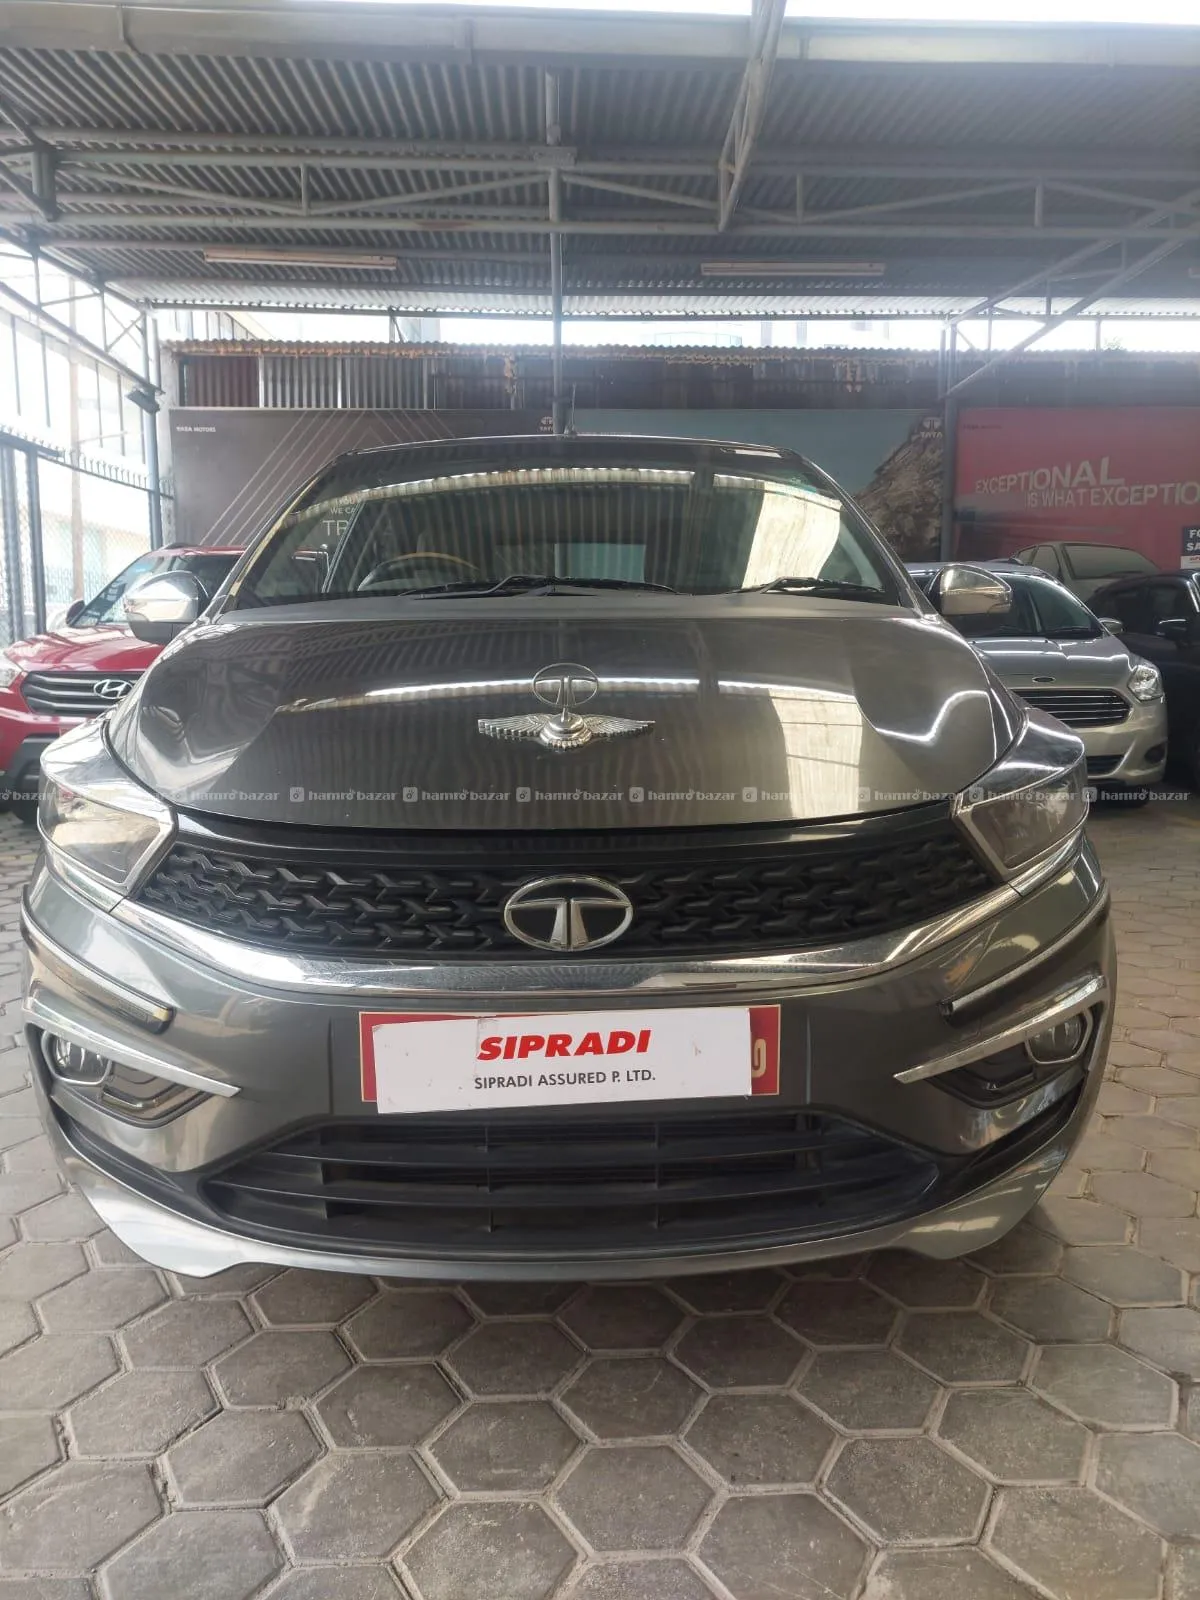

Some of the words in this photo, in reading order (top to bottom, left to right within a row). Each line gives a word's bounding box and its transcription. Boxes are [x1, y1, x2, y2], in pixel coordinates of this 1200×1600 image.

[975, 455, 1125, 495] EXCEPTIONAL
[1042, 487, 1087, 509] WHAT
[476, 1029, 652, 1061] SIPRADI
[474, 1074, 533, 1090] SIPRADI
[538, 1070, 607, 1087] ASSURED
[611, 1069, 622, 1083] P.
[626, 1068, 656, 1082] LTD.
